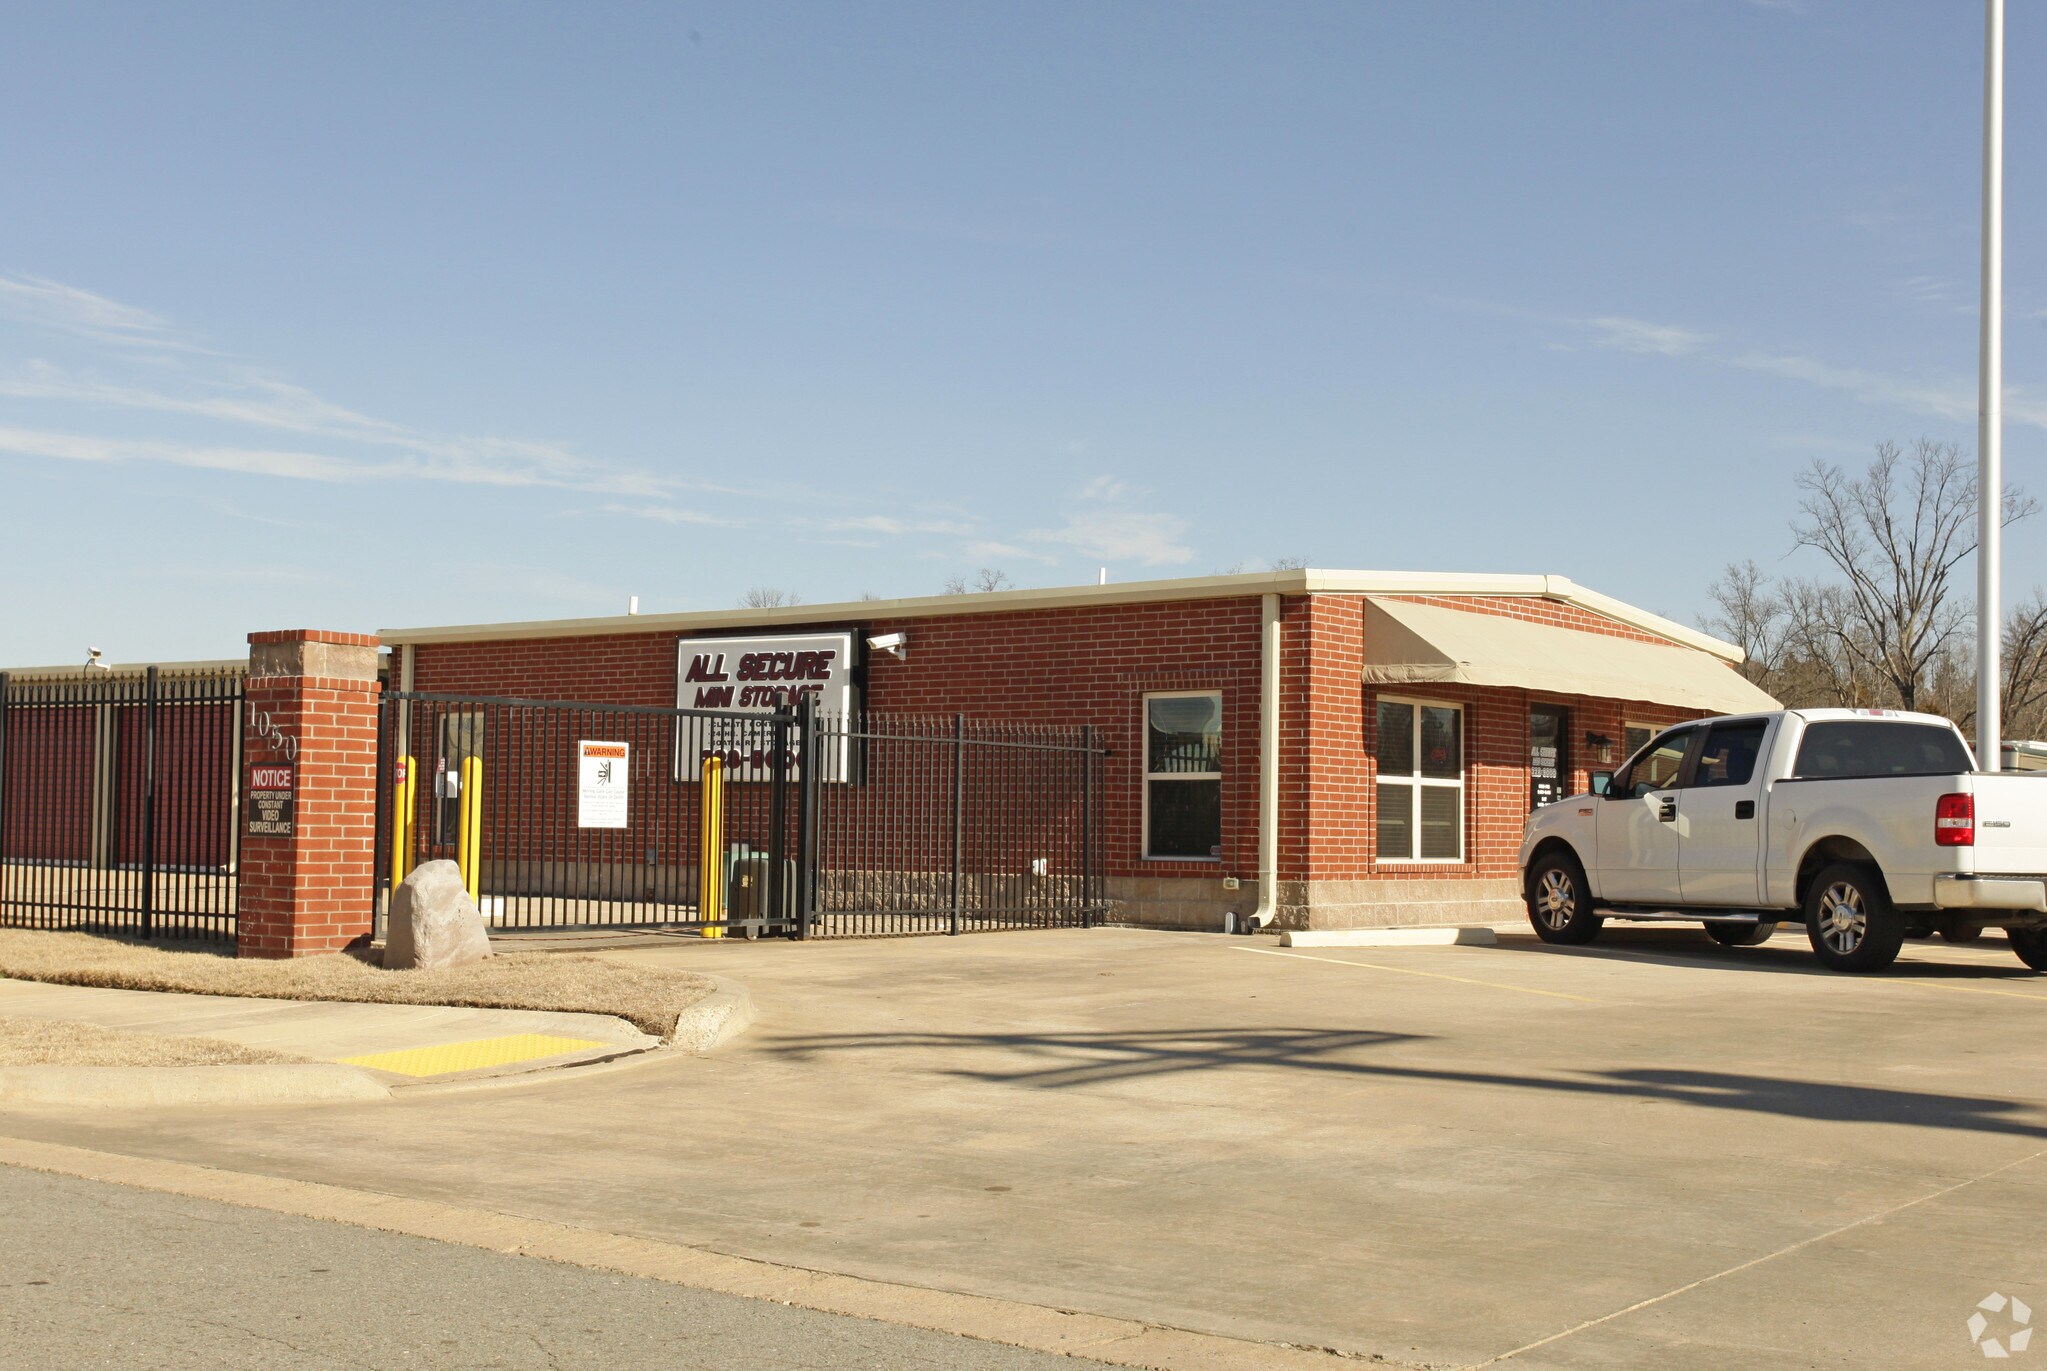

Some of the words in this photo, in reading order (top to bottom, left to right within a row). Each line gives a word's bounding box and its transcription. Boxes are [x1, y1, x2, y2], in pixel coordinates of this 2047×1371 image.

[685, 653, 730, 682] ALL
[737, 650, 836, 681] SECURE
[694, 686, 735, 708] MINI
[251, 701, 297, 761] 1050
[590, 747, 625, 757] WARNING
[253, 769, 290, 787] NOTICE
[250, 790, 275, 800] PROPERTY
[275, 791, 292, 800] UNDER
[258, 800, 283, 809] CONSTANT
[261, 810, 279, 821] VIDEO
[249, 822, 291, 834] SURVEILLANCE
